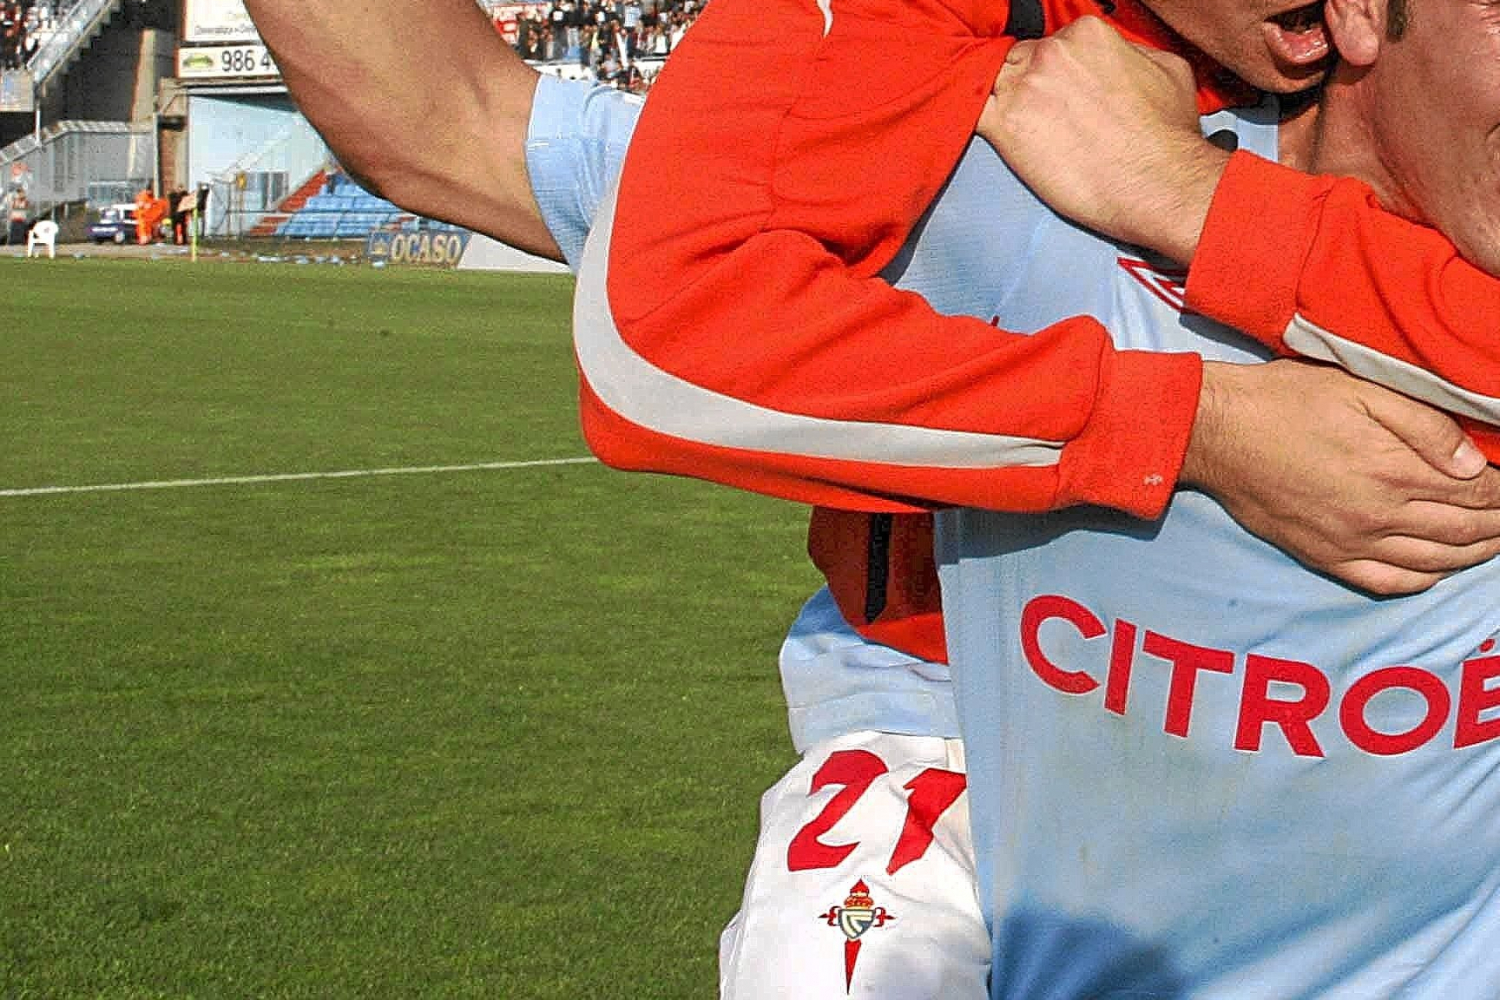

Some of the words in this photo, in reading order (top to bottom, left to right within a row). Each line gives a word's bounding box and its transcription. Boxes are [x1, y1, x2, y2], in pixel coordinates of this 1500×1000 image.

[221, 50, 255, 72] 986
[391, 233, 461, 262] OCASO
[787, 749, 967, 877] 21
